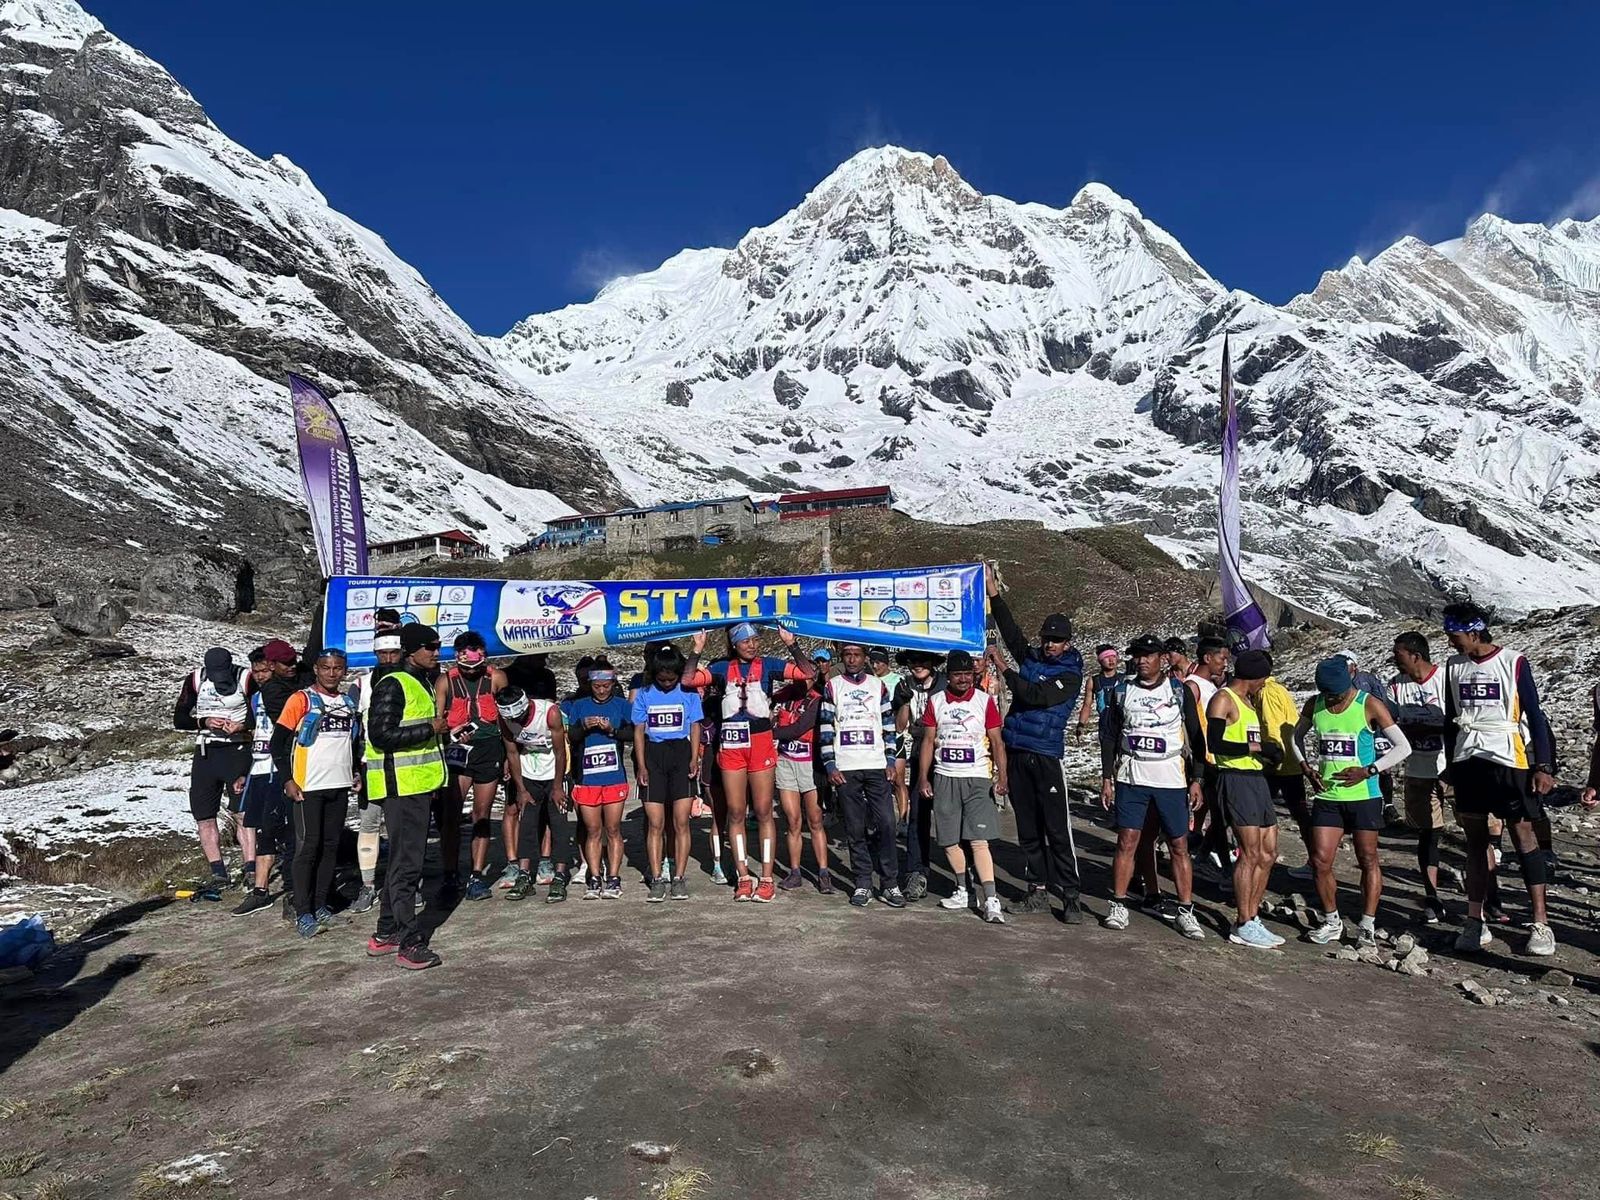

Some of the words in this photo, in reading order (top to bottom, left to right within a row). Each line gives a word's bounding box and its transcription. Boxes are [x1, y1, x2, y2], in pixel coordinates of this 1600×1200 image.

[618, 583, 801, 624] START
[502, 624, 573, 642] MARATHON
[522, 641, 542, 649] JUNE
[1470, 684, 1487, 697] 55
[657, 713, 674, 724] 09
[725, 730, 739, 741] 03
[849, 731, 865, 743] 54
[1137, 737, 1155, 750] 49
[1327, 741, 1344, 753] 34
[591, 754, 607, 766] 02
[949, 749, 964, 761] 53
